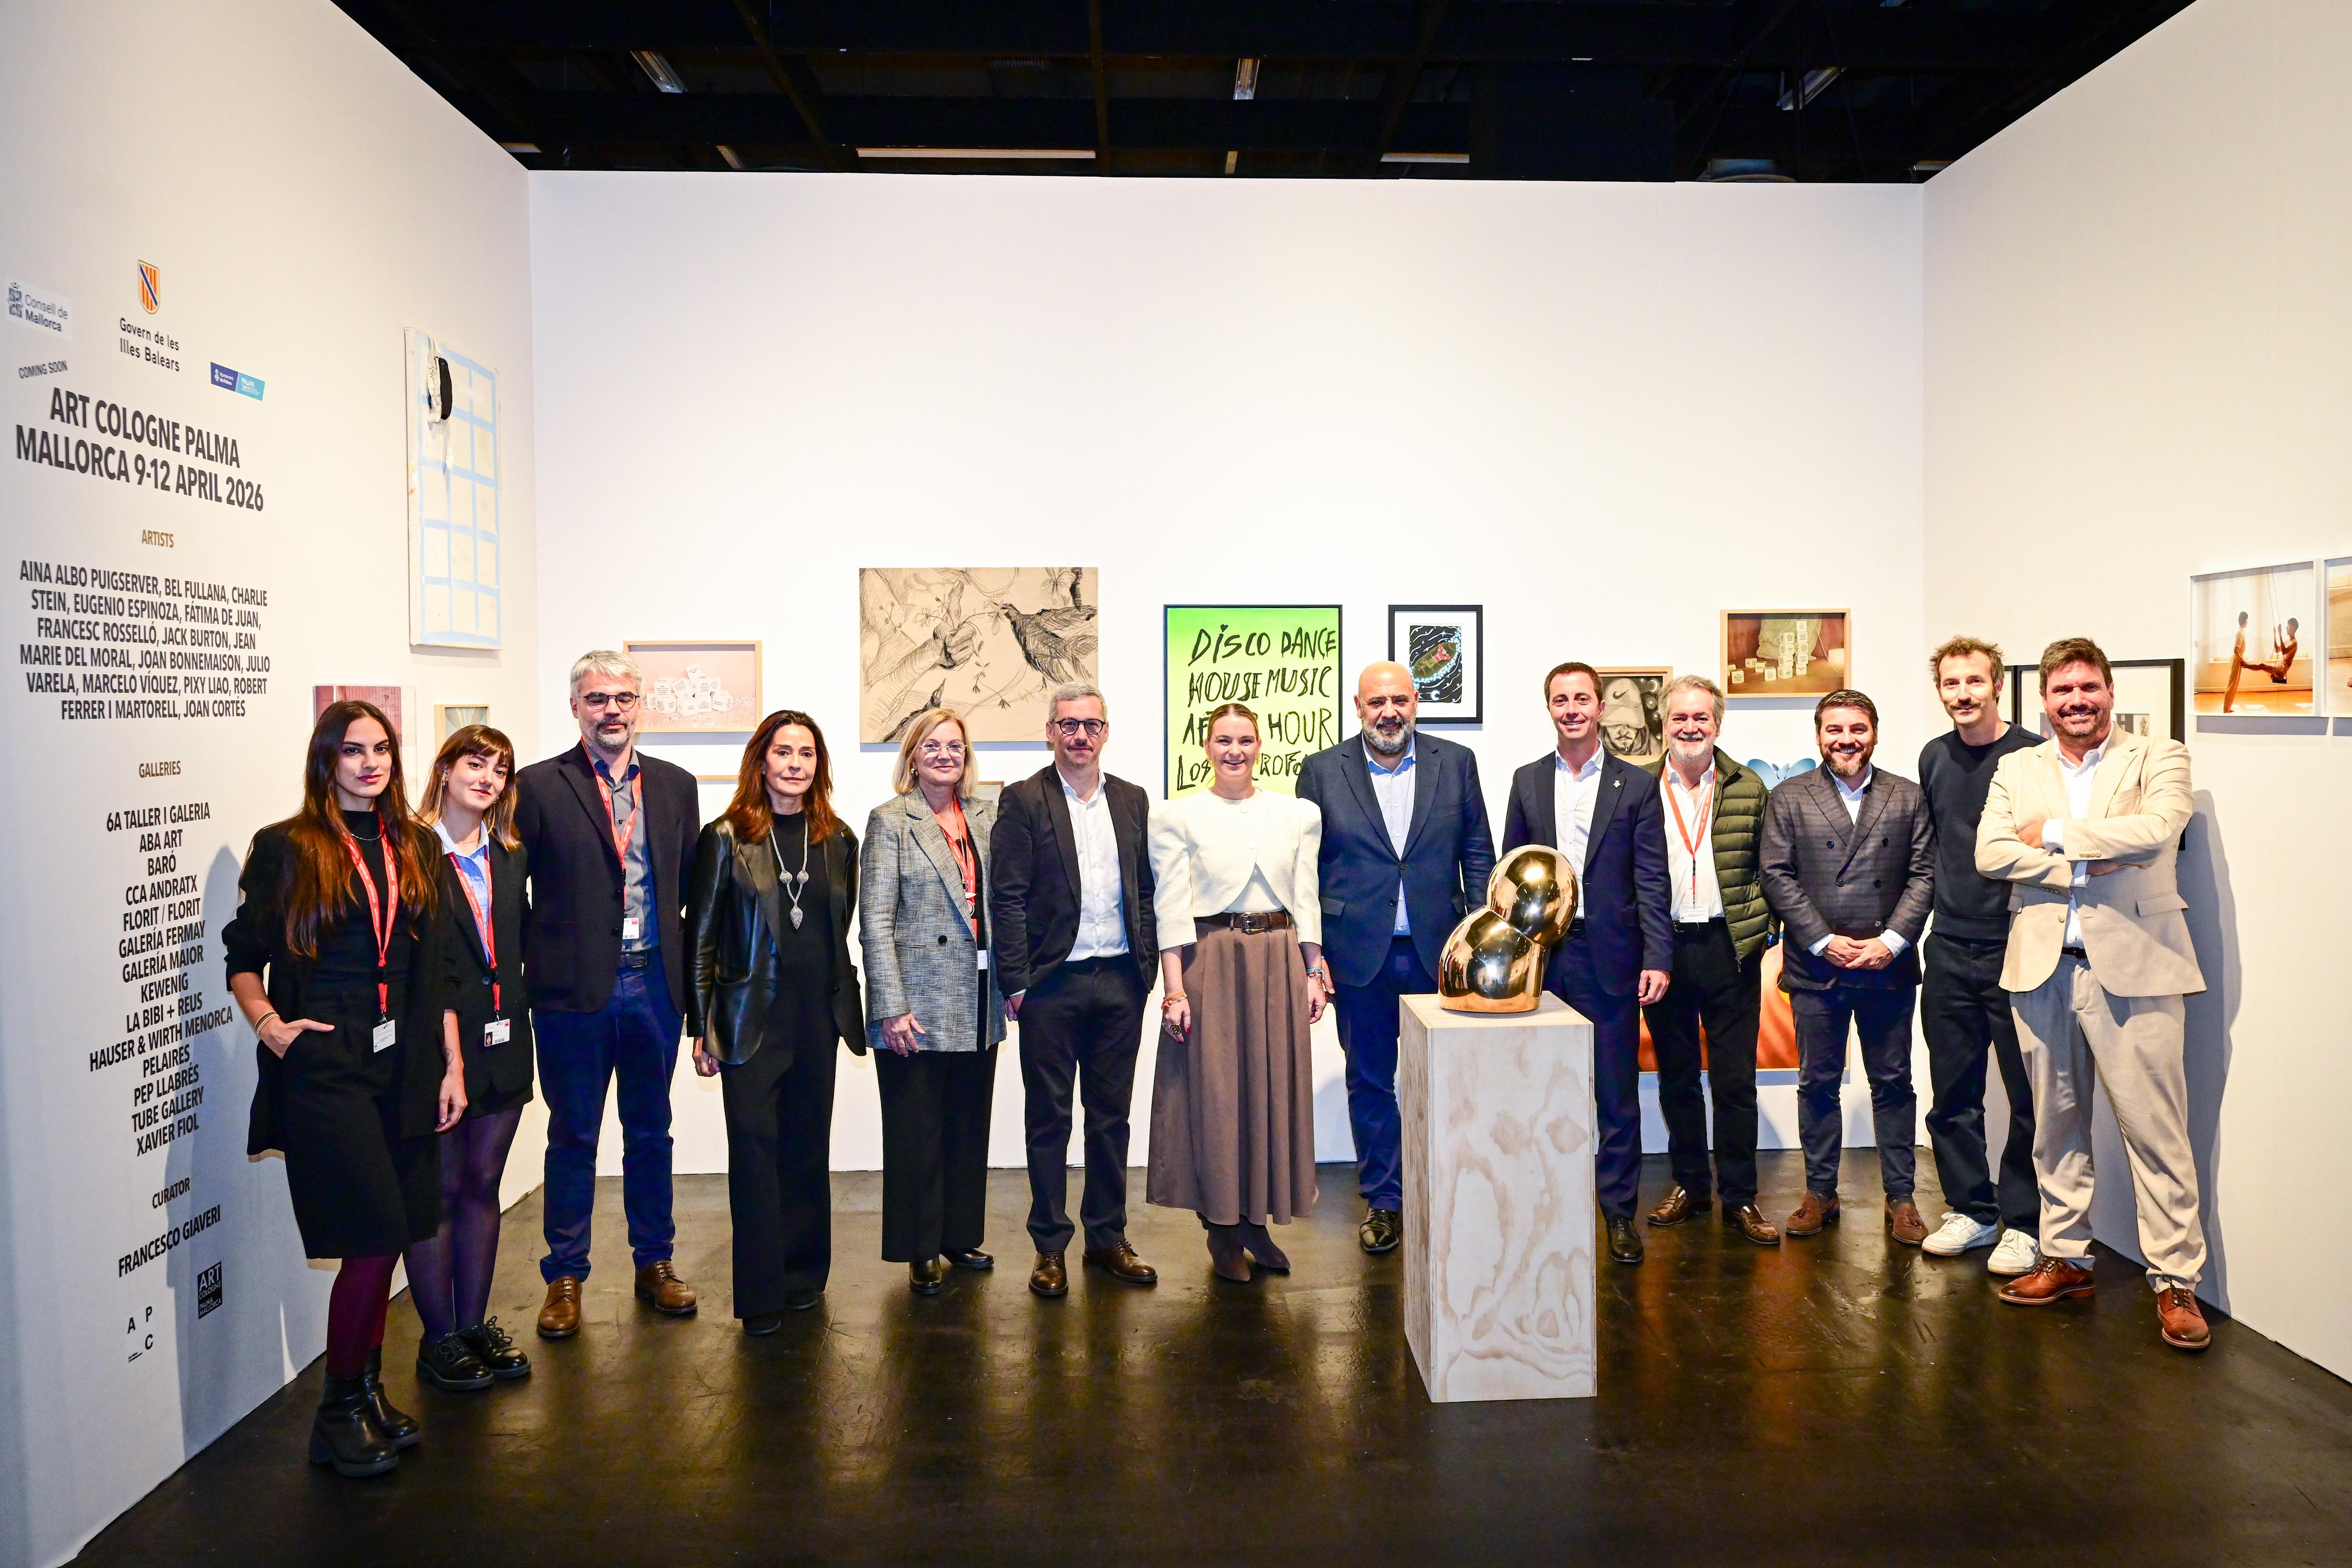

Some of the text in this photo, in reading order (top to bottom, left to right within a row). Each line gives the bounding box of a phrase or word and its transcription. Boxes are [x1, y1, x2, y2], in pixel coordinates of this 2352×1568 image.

[25, 294, 68, 319] Consell de
[26, 310, 62, 332] Mallorca
[120, 317, 179, 351] Govern de les
[18, 361, 68, 379] COMING SOON
[120, 338, 179, 371] Illes Balears
[50, 387, 240, 468] ART COLOGNE PALMA
[16, 425, 263, 511] MALLORCA 9-12 APRIL 2026
[142, 530, 173, 548] ARTISTS
[20, 560, 267, 606] AINA ALBO PUIGSERVER, BEL FULLANA, CHARLIE
[31, 589, 261, 630] STEIN, EUGENIO ESPINOZA, FÁTIMA DE JUAN,
[38, 617, 255, 651] FRANCESC ROSSELLÓ, JACK BURTON, JEAN
[1282, 627, 1336, 659] DANCE
[20, 644, 270, 674] MARIE DEL MORAL, JOAN BONNEMAISON, JULIO
[26, 670, 267, 696] VARELA, MARCELO VÍQUEZ, PIXY LIAO, ROBERT
[1188, 666, 1332, 707] HOUSE MUSIC
[61, 696, 245, 720] FERRER I MARTORELL, JOAN CORTÉS
[1268, 708, 1334, 751] HOUR
[139, 761, 181, 778] GALLERIES
[107, 802, 210, 832] 6A TALLER I GALERIA
[139, 829, 183, 853] ABA ART
[148, 850, 176, 876] BARÓ
[126, 875, 198, 906] CCA ANDRATX
[123, 906, 159, 932] FLORIT
[168, 898, 201, 922] FLORIT
[119, 920, 205, 958] GALERÍA FERMAY
[123, 945, 204, 983] GALERÍA MAIOR
[141, 973, 188, 1003] KEWENIG
[127, 1012, 140, 1033] LA
[143, 1004, 164, 1028] BIBI
[178, 992, 202, 1016] REUS
[90, 1006, 233, 1072] HAUSER & WIRTH MENORCA
[143, 1043, 190, 1077] PELAIRES
[134, 1062, 199, 1107] PEP LLABRÉS
[132, 1086, 204, 1132] TUBE GALLERY
[137, 1112, 199, 1156] XAVIER FIOL
[152, 1177, 190, 1209] CURATOR
[119, 1204, 220, 1278] FRANCESCO GIAVERI
[199, 1263, 220, 1292] ART
[199, 1281, 220, 1299] COLOGNE
[127, 1306, 152, 1334] A P
[199, 1297, 213, 1311] PALMA
[145, 1334, 153, 1350] C
